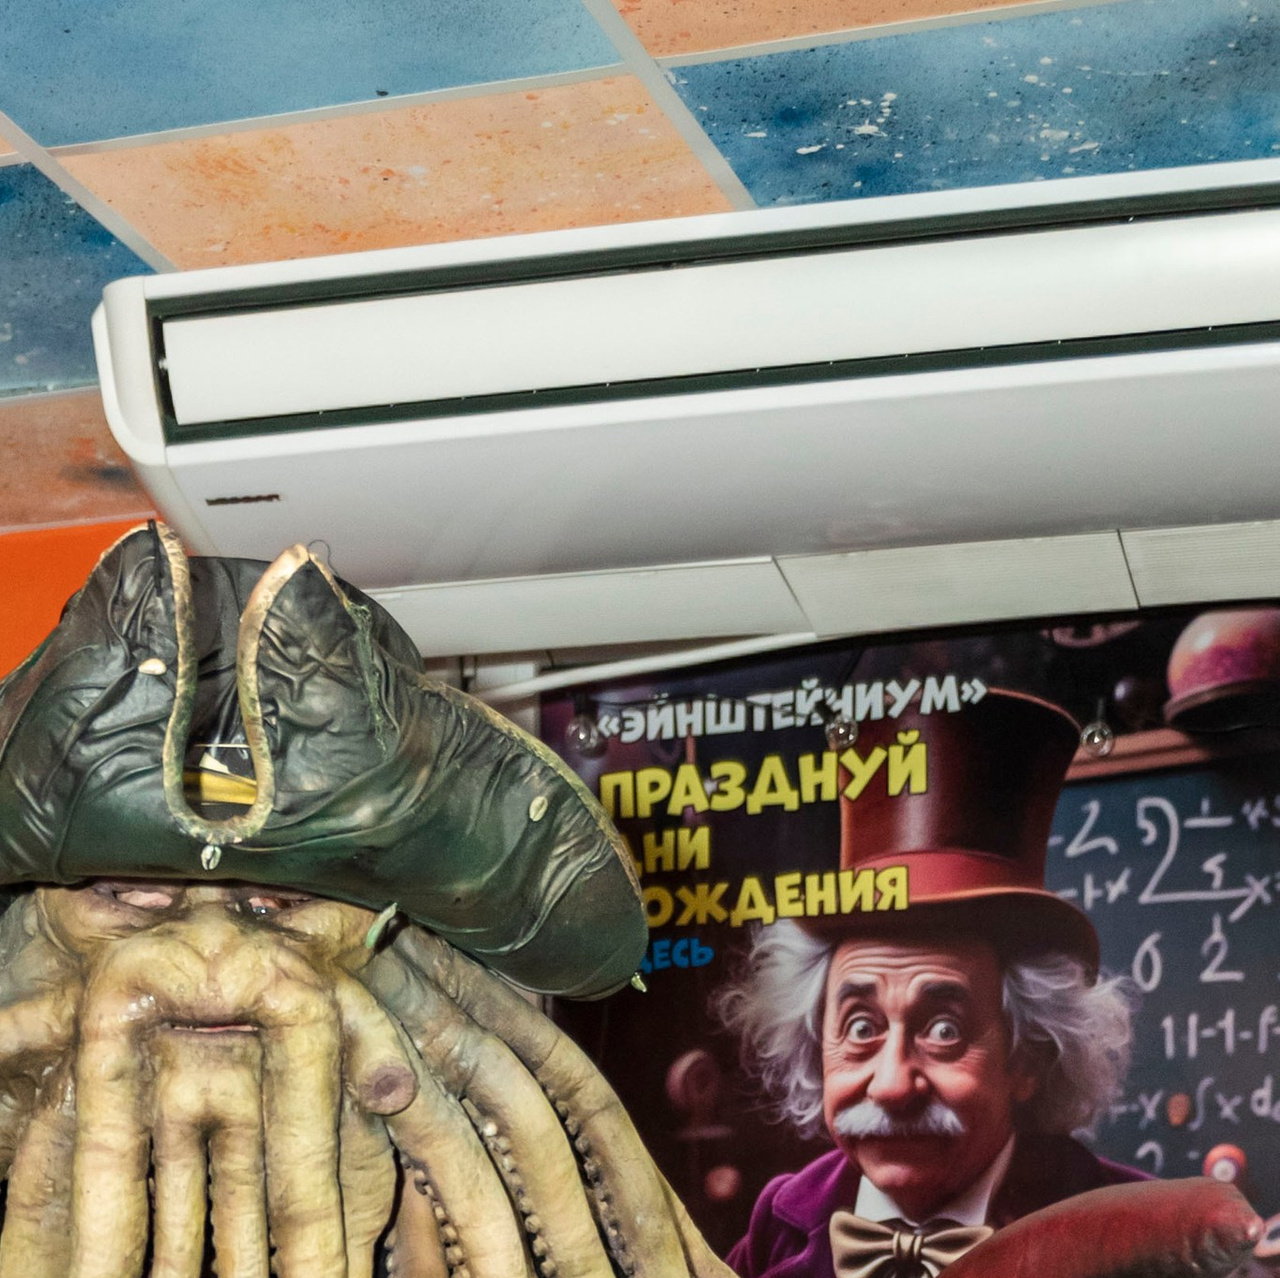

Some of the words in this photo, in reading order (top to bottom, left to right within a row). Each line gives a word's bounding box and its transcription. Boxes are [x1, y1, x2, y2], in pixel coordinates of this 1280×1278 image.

[598, 728, 928, 820] ПРАЗДНУЙ
[620, 825, 711, 878] НИ
[641, 865, 910, 929] ОЖДЕНИЯ
[638, 937, 715, 975] ЕСЬ
